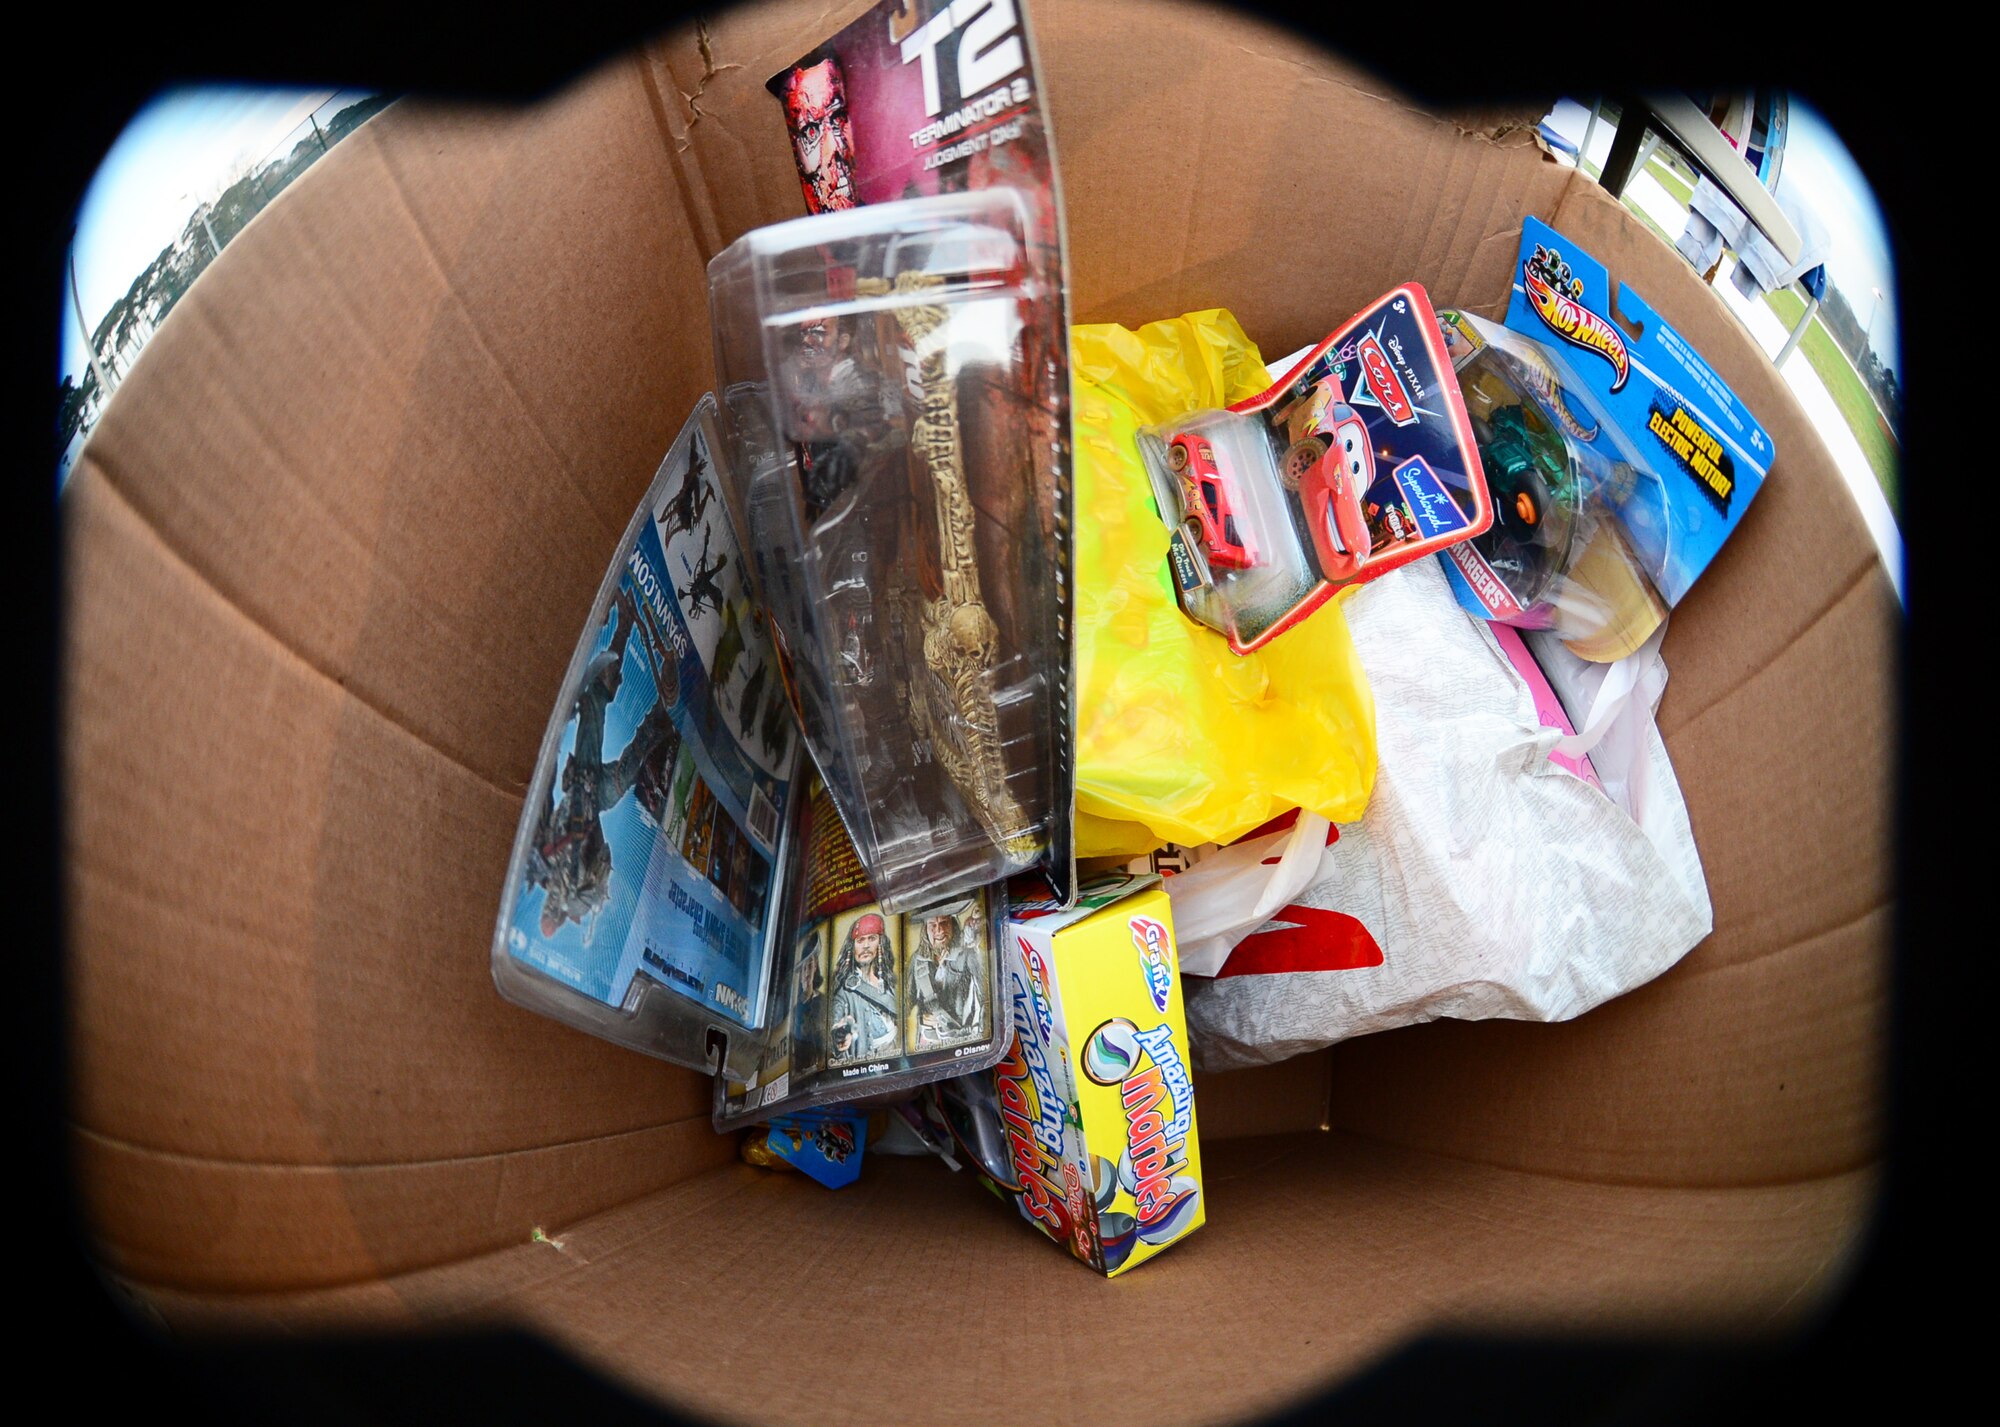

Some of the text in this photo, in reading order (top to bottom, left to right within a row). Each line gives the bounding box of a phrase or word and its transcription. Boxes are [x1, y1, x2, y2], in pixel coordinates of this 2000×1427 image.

[901, 0, 1024, 118] T2
[909, 78, 1031, 150] TERMINATOR 2
[923, 138, 988, 171] JUDGMENT
[1392, 300, 1406, 314] 3+
[1363, 347, 1402, 416] Cars
[1388, 335, 1426, 400] Disney PIXAR
[1649, 412, 1693, 461] ELECTRIC
[1689, 454, 1732, 499] MOTOR!
[1671, 408, 1724, 462] POWERFUL
[1750, 429, 1766, 453] 5+
[1171, 543, 1188, 584] McQueen
[1178, 543, 1194, 578] Dirt Track
[1453, 544, 1505, 610] HARGERS
[839, 884, 854, 894] what
[1029, 949, 1053, 1030] Grafix
[1145, 924, 1170, 993] Grafix
[842, 1067, 859, 1077] Made
[868, 1062, 889, 1072] China
[1132, 1023, 1193, 1140] Amazing
[1121, 1064, 1188, 1223] Marbles
